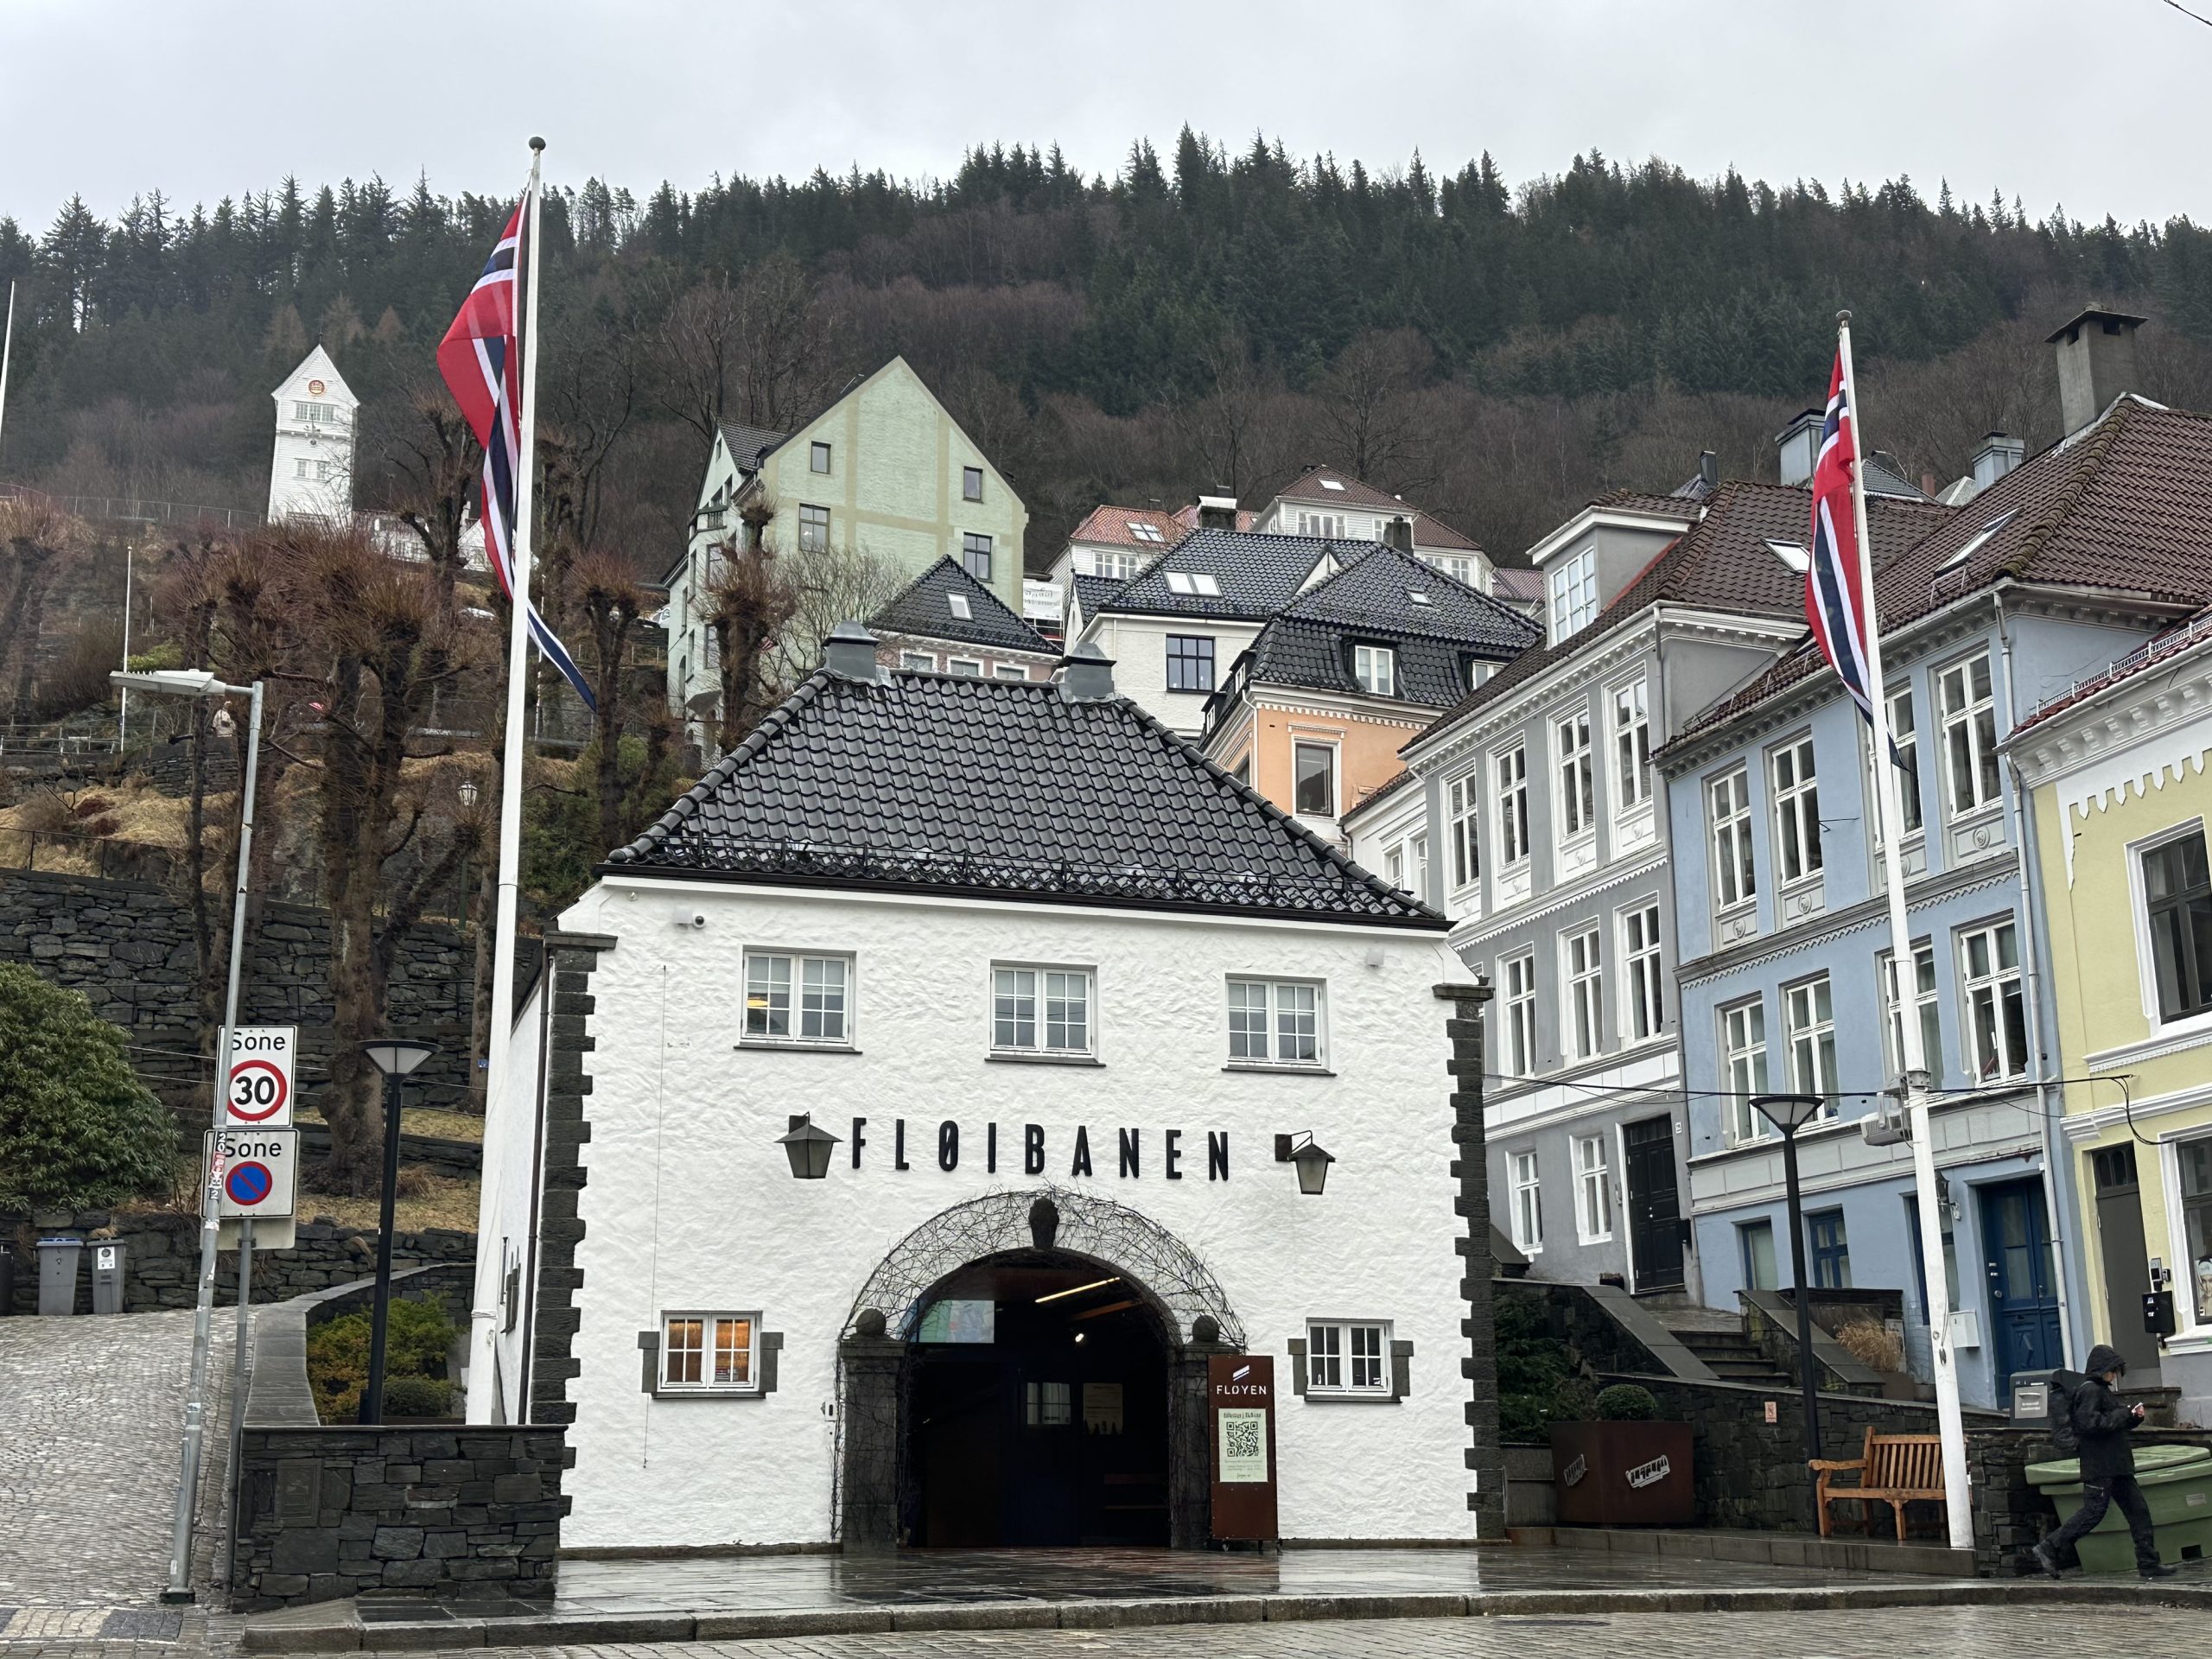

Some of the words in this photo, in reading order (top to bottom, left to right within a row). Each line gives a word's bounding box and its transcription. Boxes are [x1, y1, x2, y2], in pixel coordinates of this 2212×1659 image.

[231, 1031, 286, 1052] Sone
[233, 1075, 276, 1106] 30
[224, 1138, 282, 1158] Sone
[851, 1116, 1229, 1182] FLØIBANEN
[1216, 1384, 1267, 1395] FLØYEN
